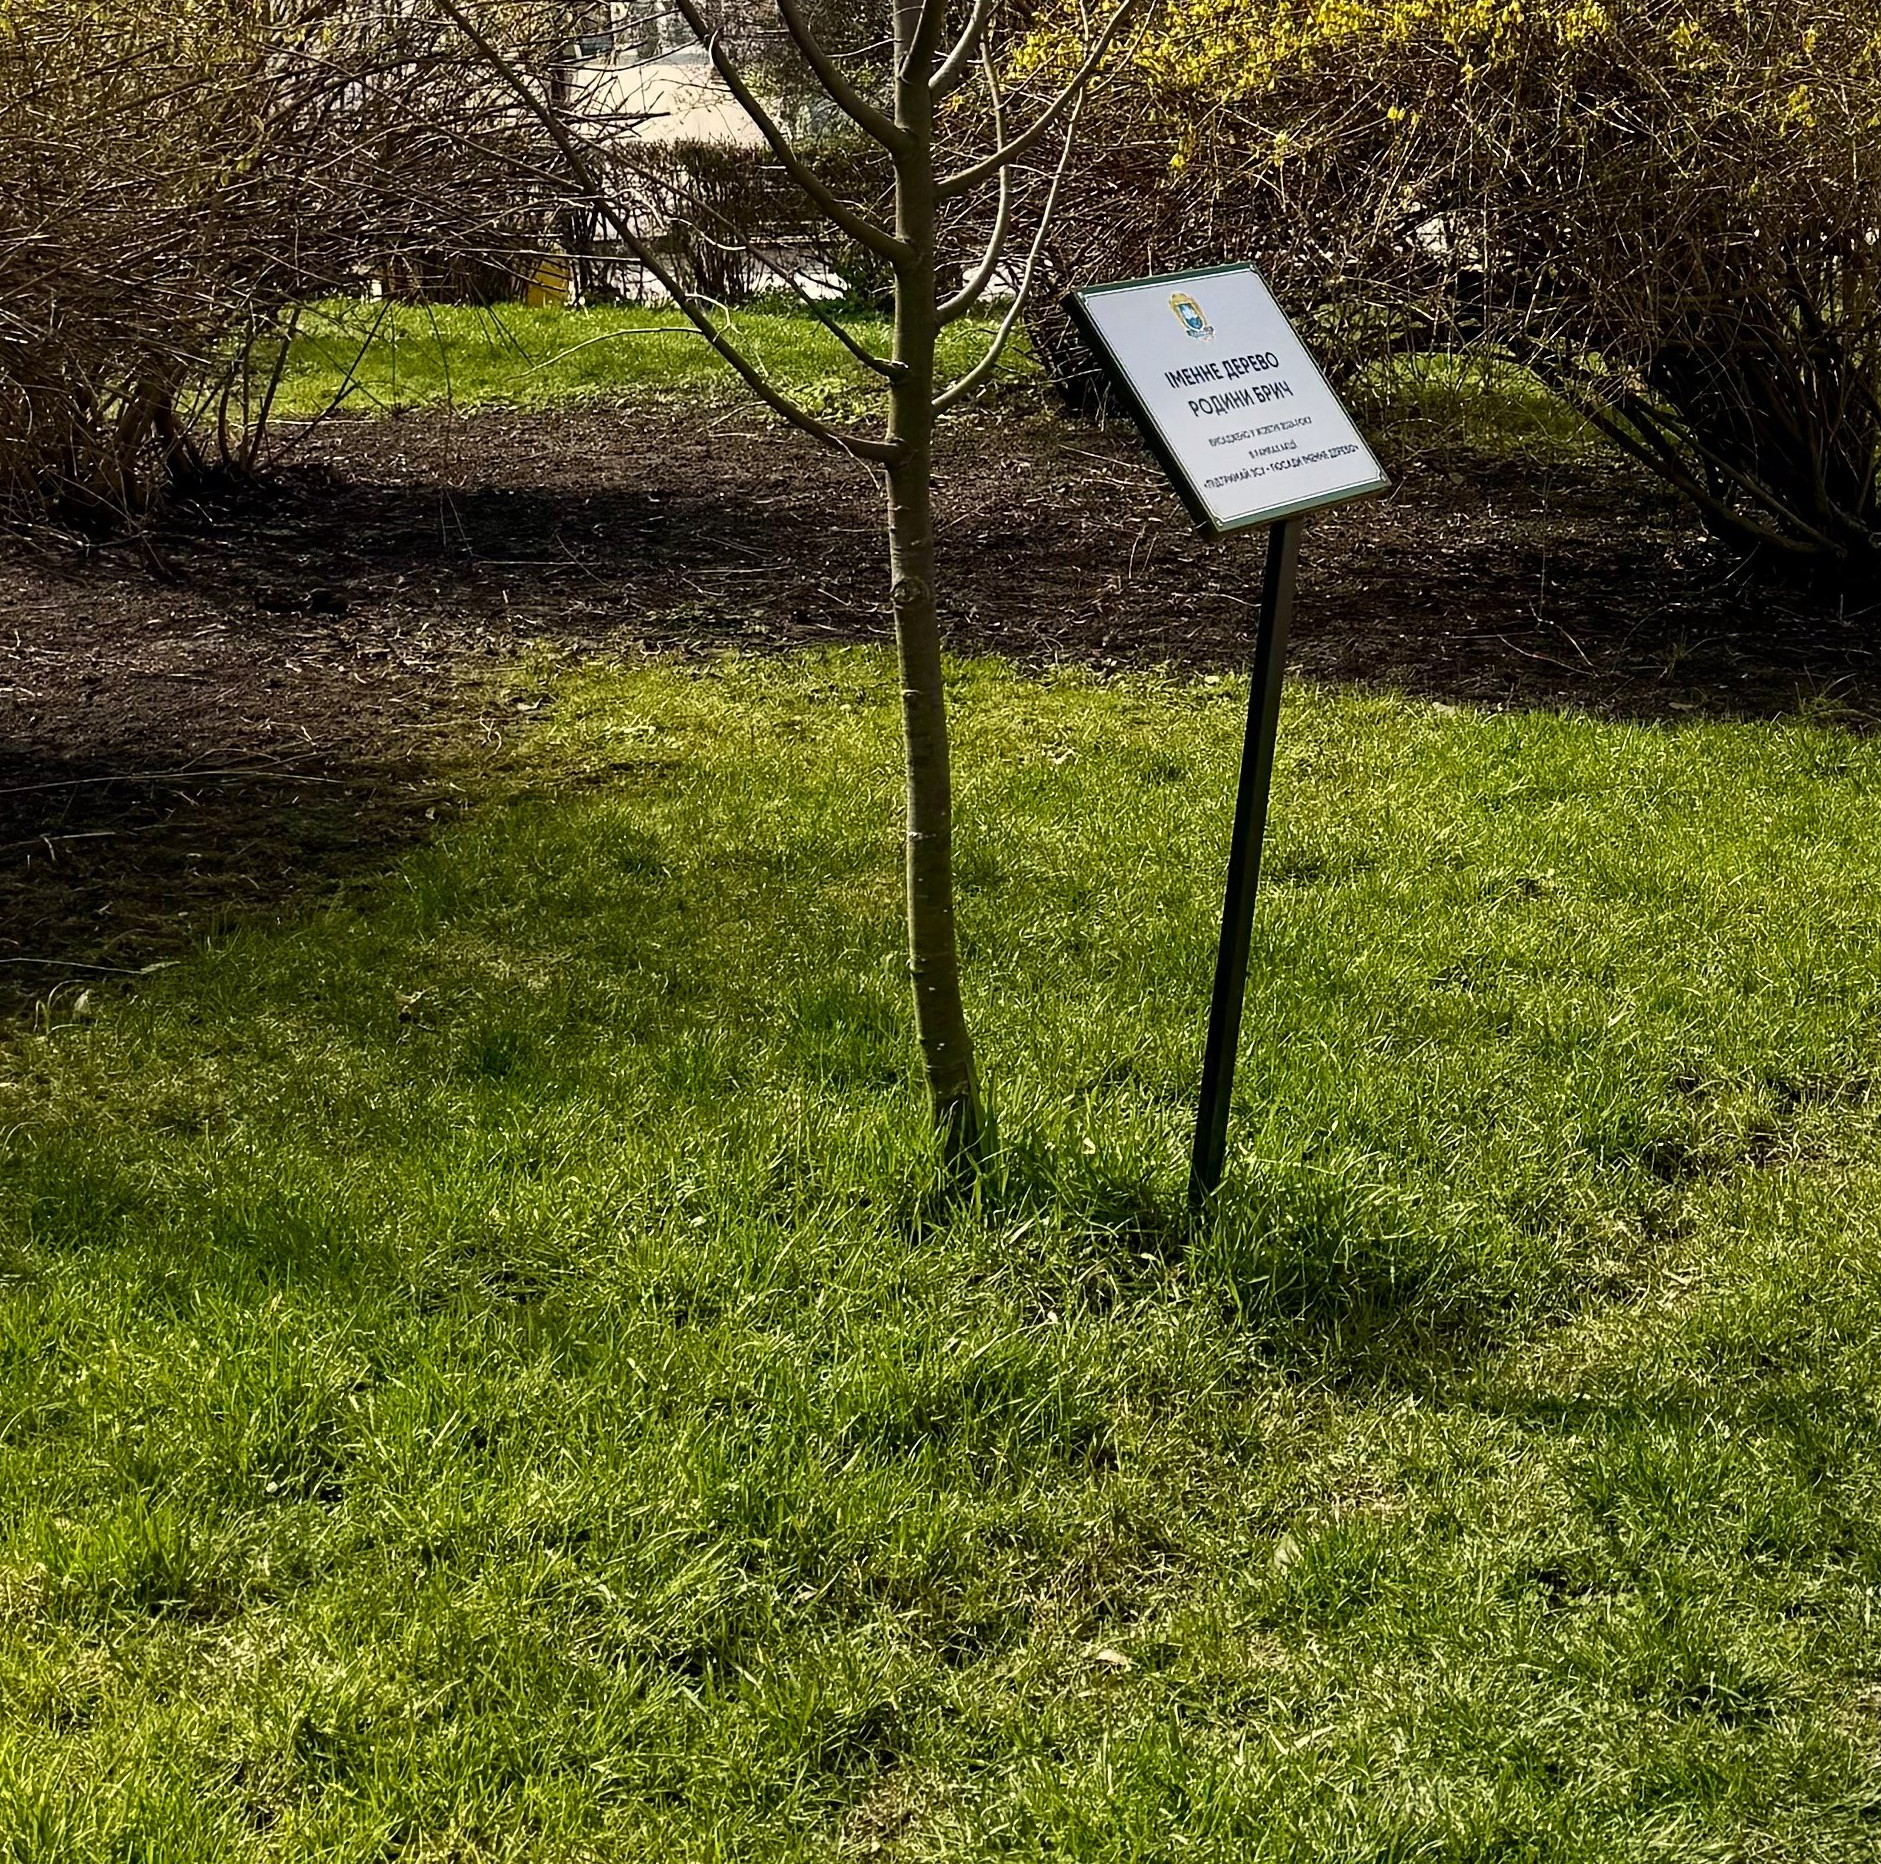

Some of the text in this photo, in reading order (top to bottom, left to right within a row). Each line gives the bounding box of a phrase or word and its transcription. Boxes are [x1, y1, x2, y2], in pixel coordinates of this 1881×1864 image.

[1164, 351, 1279, 389] ІМЕННЕ ДЕРЕВО
[1188, 380, 1294, 417] РОДИНИ БРИЧ
